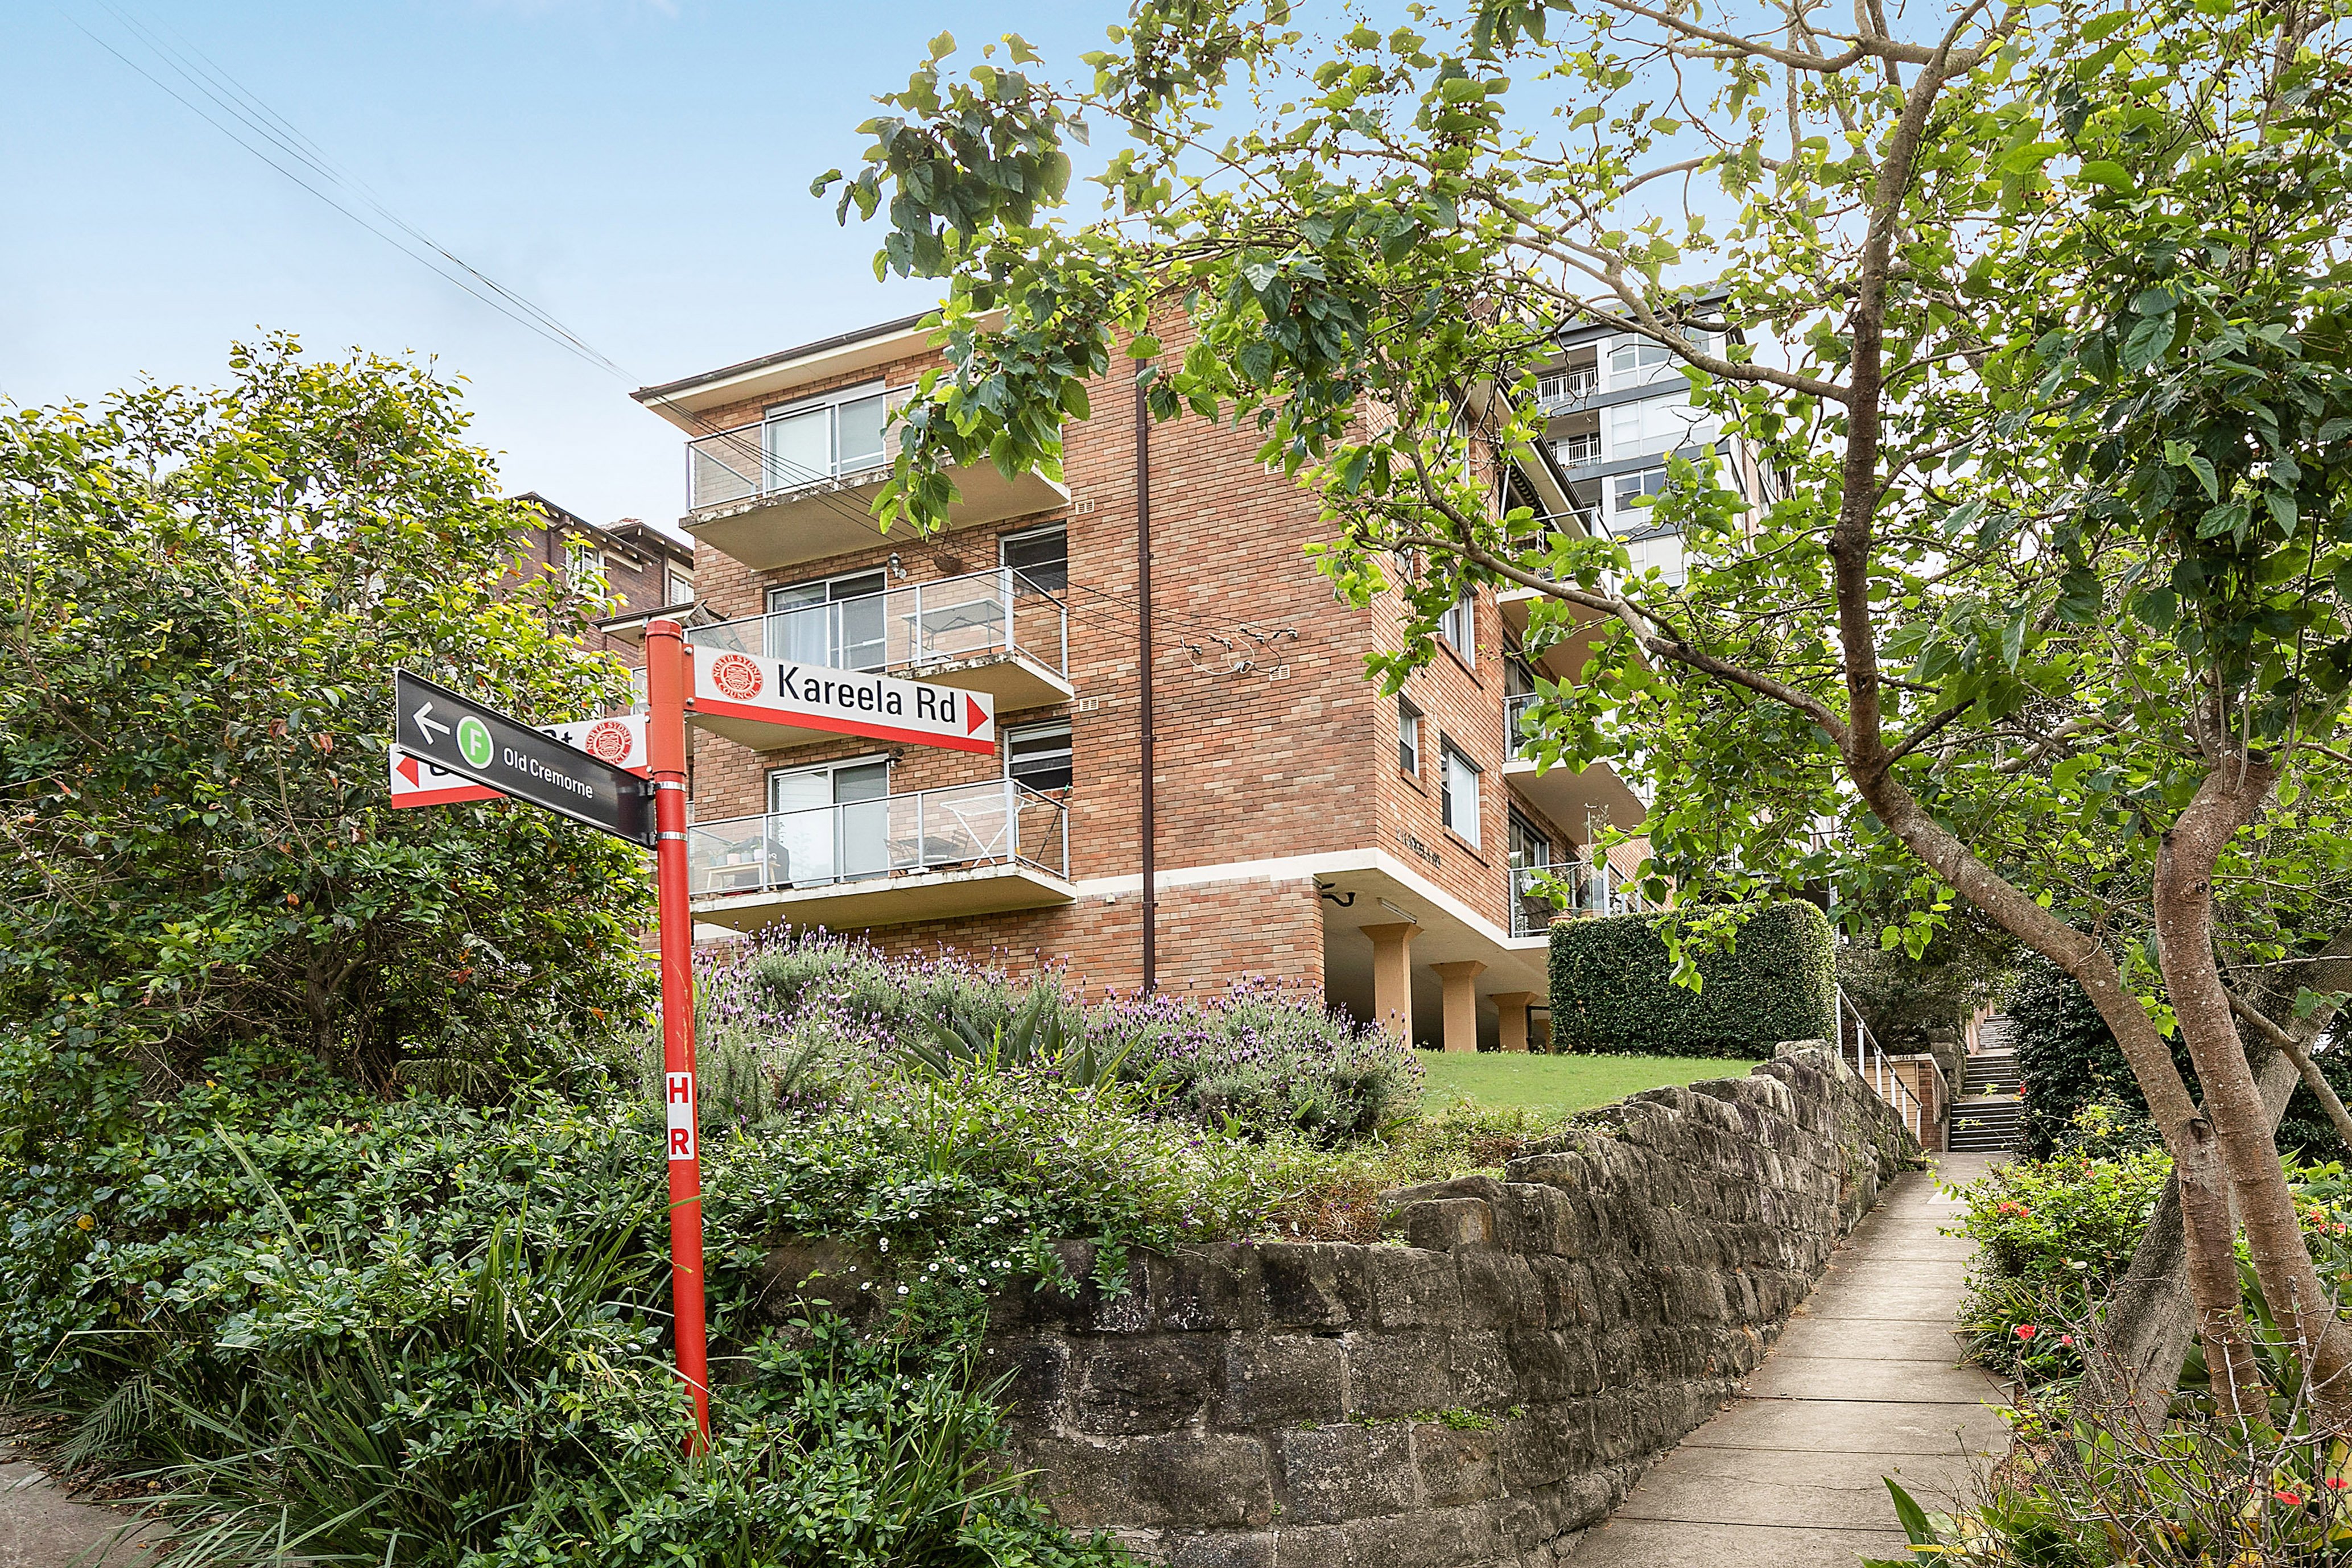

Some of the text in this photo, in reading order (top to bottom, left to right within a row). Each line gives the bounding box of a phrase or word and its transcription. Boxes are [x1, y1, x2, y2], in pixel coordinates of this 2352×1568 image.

[713, 655, 762, 684] NORTH SYDNEY
[719, 682, 757, 699] COUNCIL
[778, 664, 956, 723] Kareela Rd
[587, 722, 631, 750] NORTH SYDNEY
[470, 727, 593, 799] F Old Cremorne
